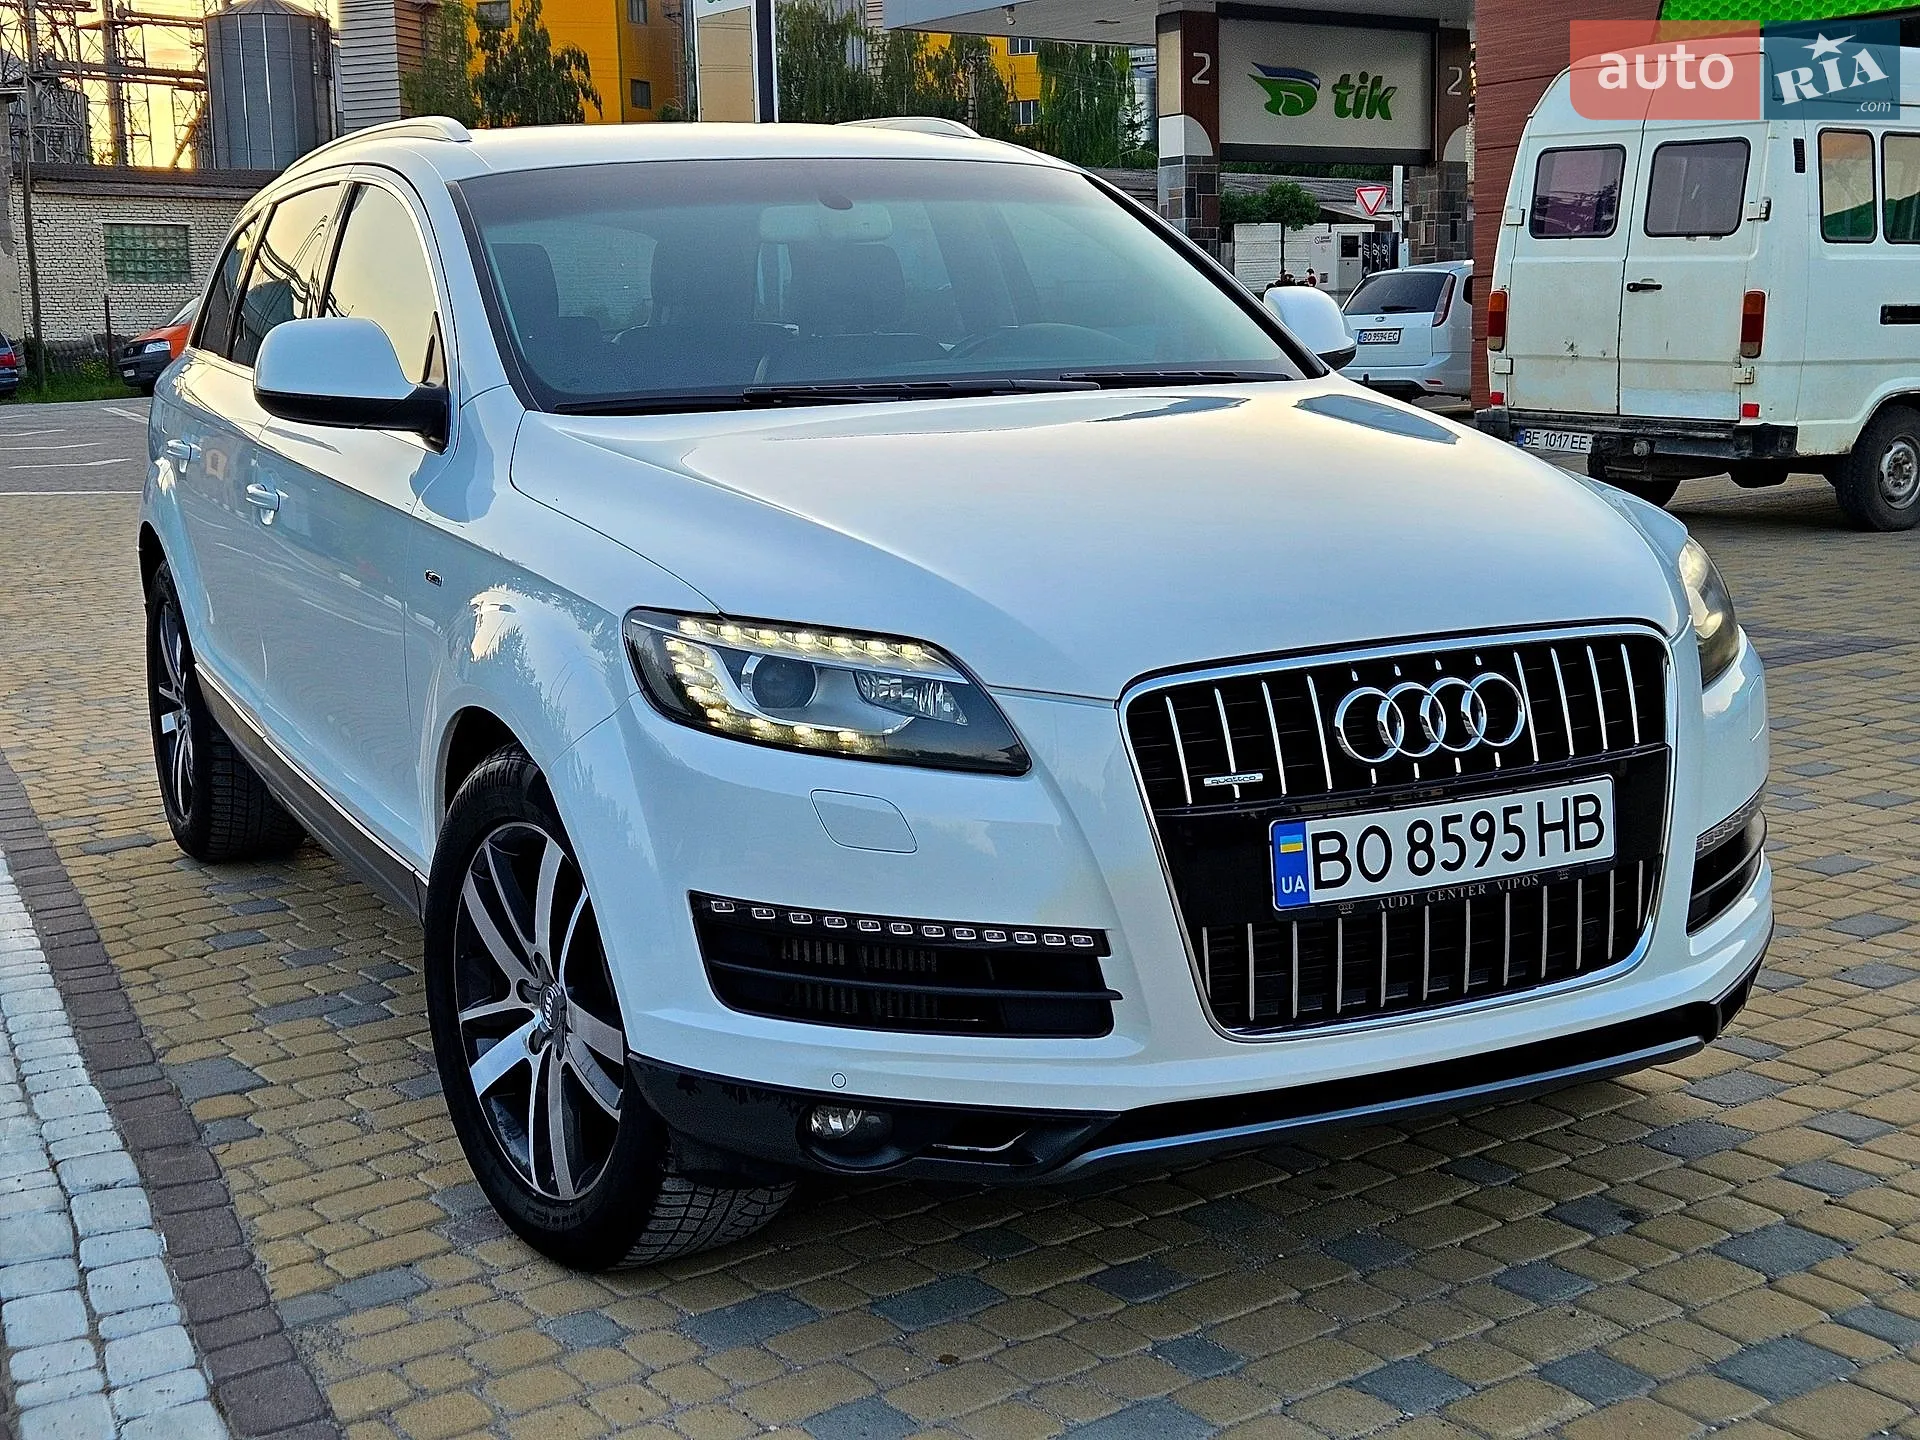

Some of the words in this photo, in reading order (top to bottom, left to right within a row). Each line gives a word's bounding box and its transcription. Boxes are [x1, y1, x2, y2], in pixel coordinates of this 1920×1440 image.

[1191, 53, 1211, 84] 2
[1447, 67, 1463, 96] 2
[1331, 71, 1398, 121] tik
[1524, 431, 1540, 445] BE
[1544, 432, 1569, 448] 1017
[1571, 435, 1587, 450] EE
[1311, 824, 1393, 891] BO
[1407, 804, 1526, 877] 8595
[1537, 793, 1605, 858] HB
[1282, 876, 1306, 894] UA
[1377, 895, 1415, 910] AUDI
[1427, 885, 1487, 903] CENTER
[1497, 875, 1540, 892] VIPOS
